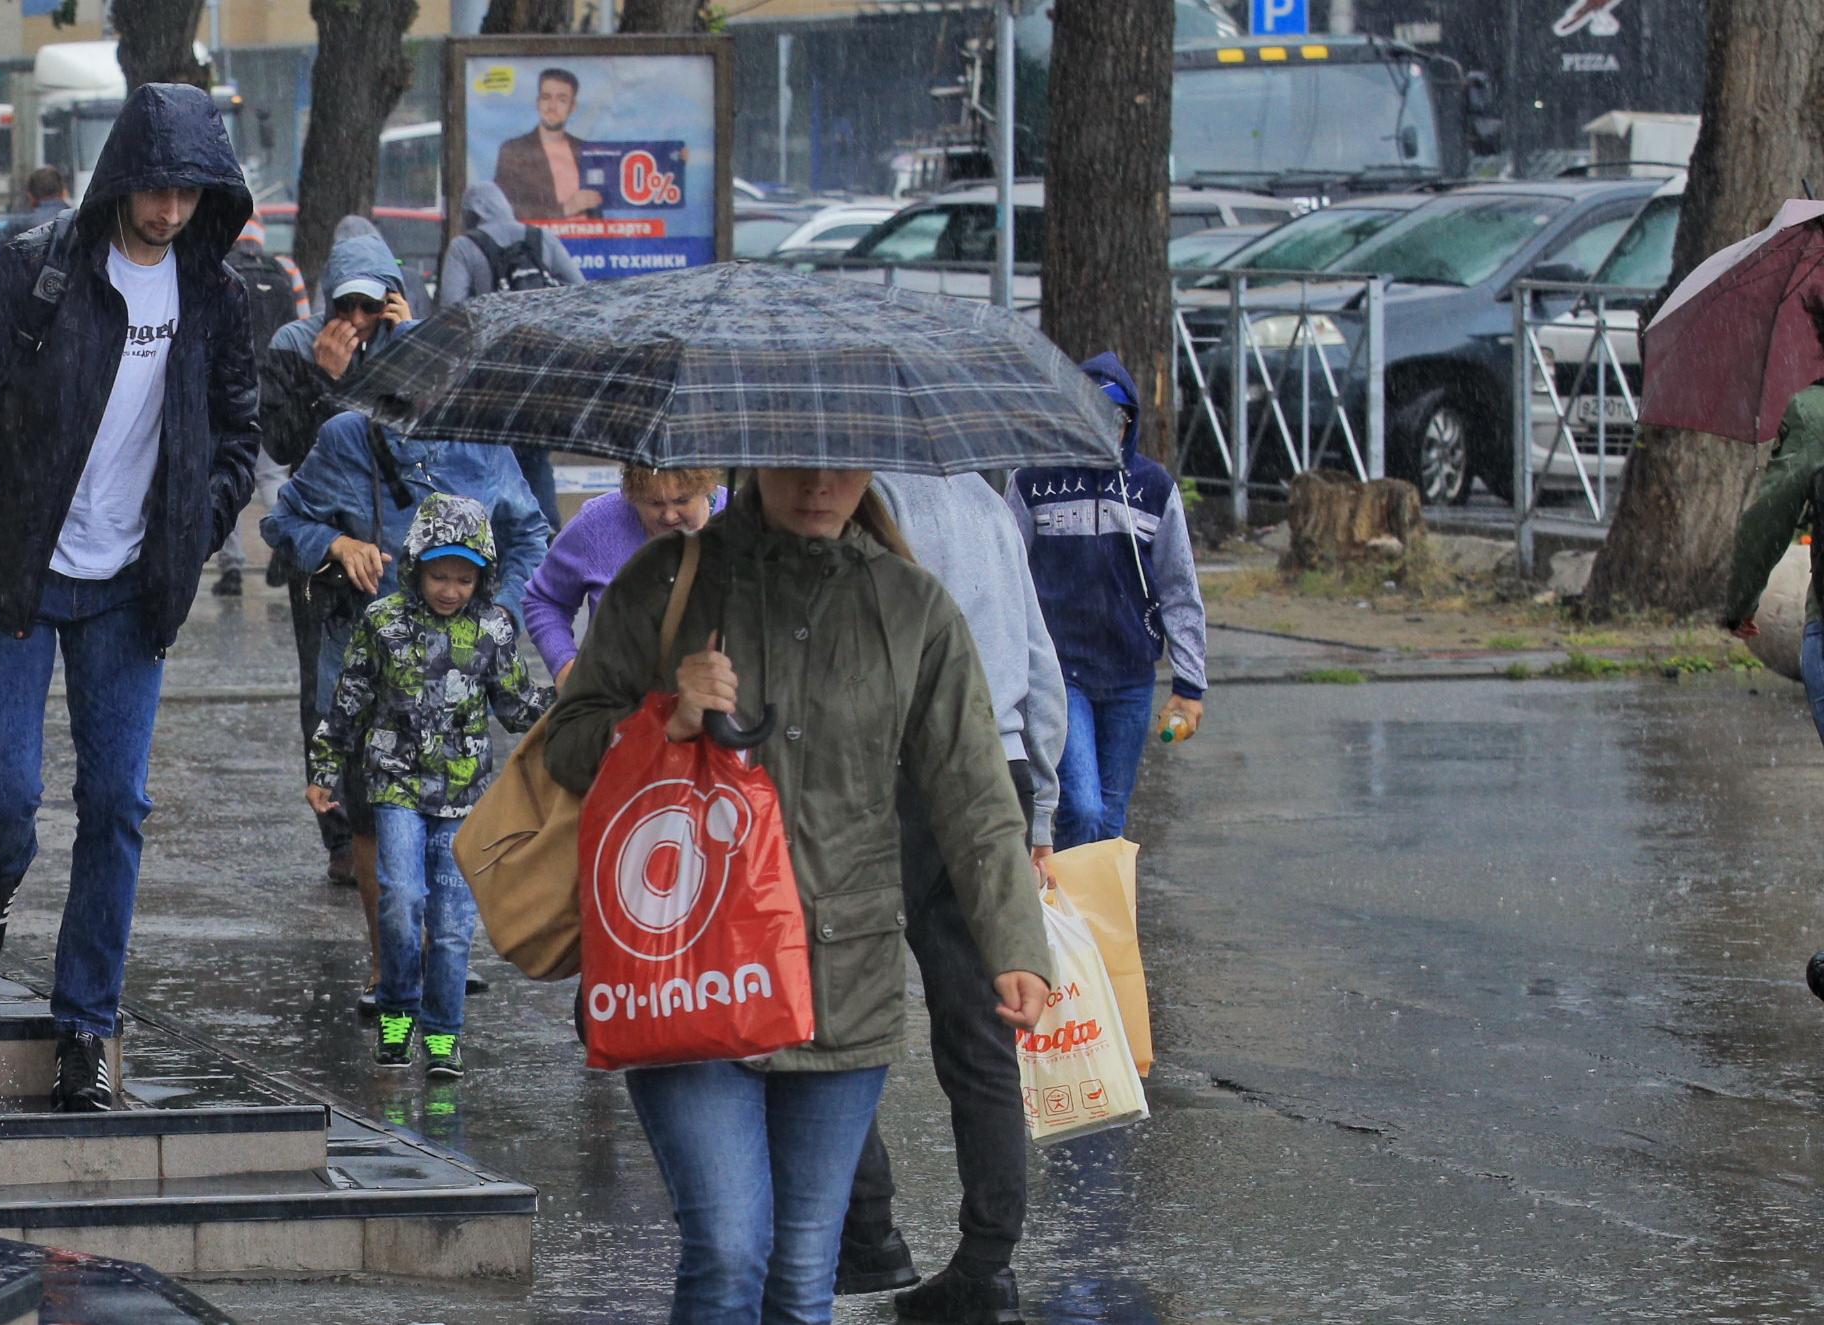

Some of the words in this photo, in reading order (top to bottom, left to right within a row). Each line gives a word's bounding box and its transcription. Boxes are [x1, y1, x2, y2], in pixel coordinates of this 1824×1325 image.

[1264, 0, 1294, 32] P
[1561, 53, 1620, 71] PIZZA
[621, 151, 681, 205] 0%
[608, 223, 651, 237] карта
[575, 256, 605, 268] ело
[610, 254, 687, 268] техники
[126, 318, 176, 346] ngel
